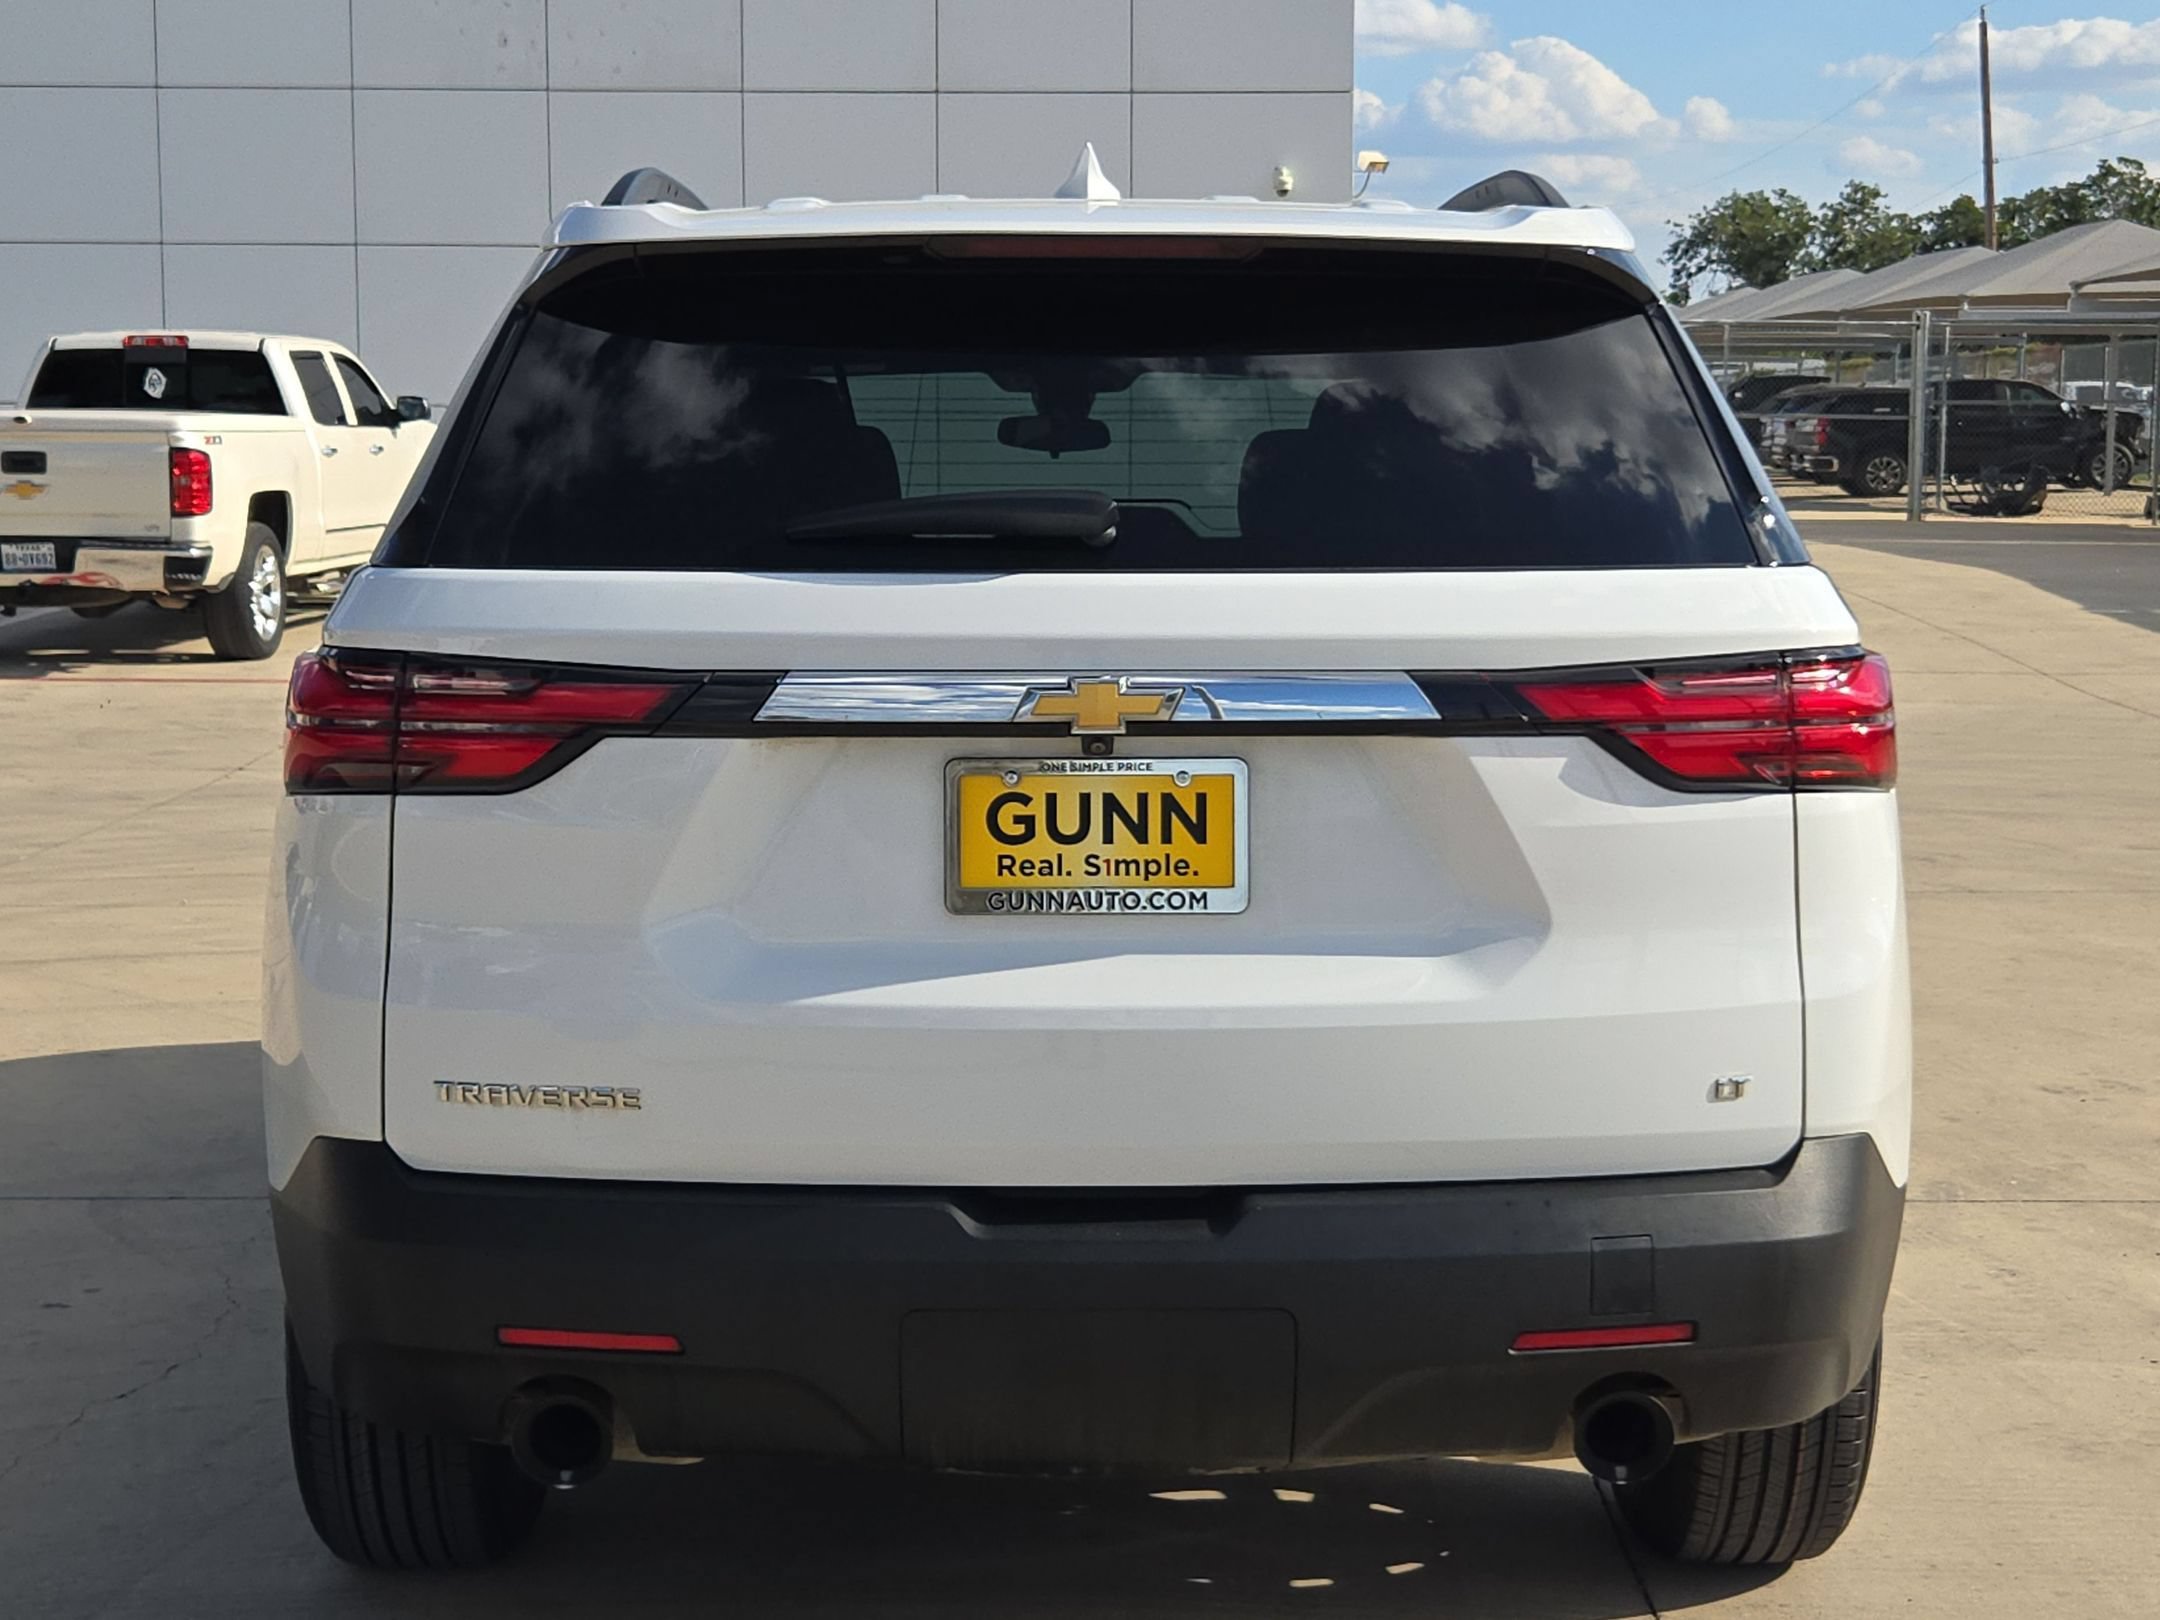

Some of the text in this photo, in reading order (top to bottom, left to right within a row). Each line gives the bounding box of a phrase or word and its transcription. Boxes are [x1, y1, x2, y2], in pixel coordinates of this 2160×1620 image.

[1040, 762, 1153, 773] ONE SIMPLE PRICE
[986, 791, 1207, 846] GUNN
[997, 853, 1072, 877] Real.
[988, 891, 1209, 911] GUNNAUTO.COM
[433, 1080, 642, 1110] TRAVERSE
[1707, 1075, 1752, 1103] LT
